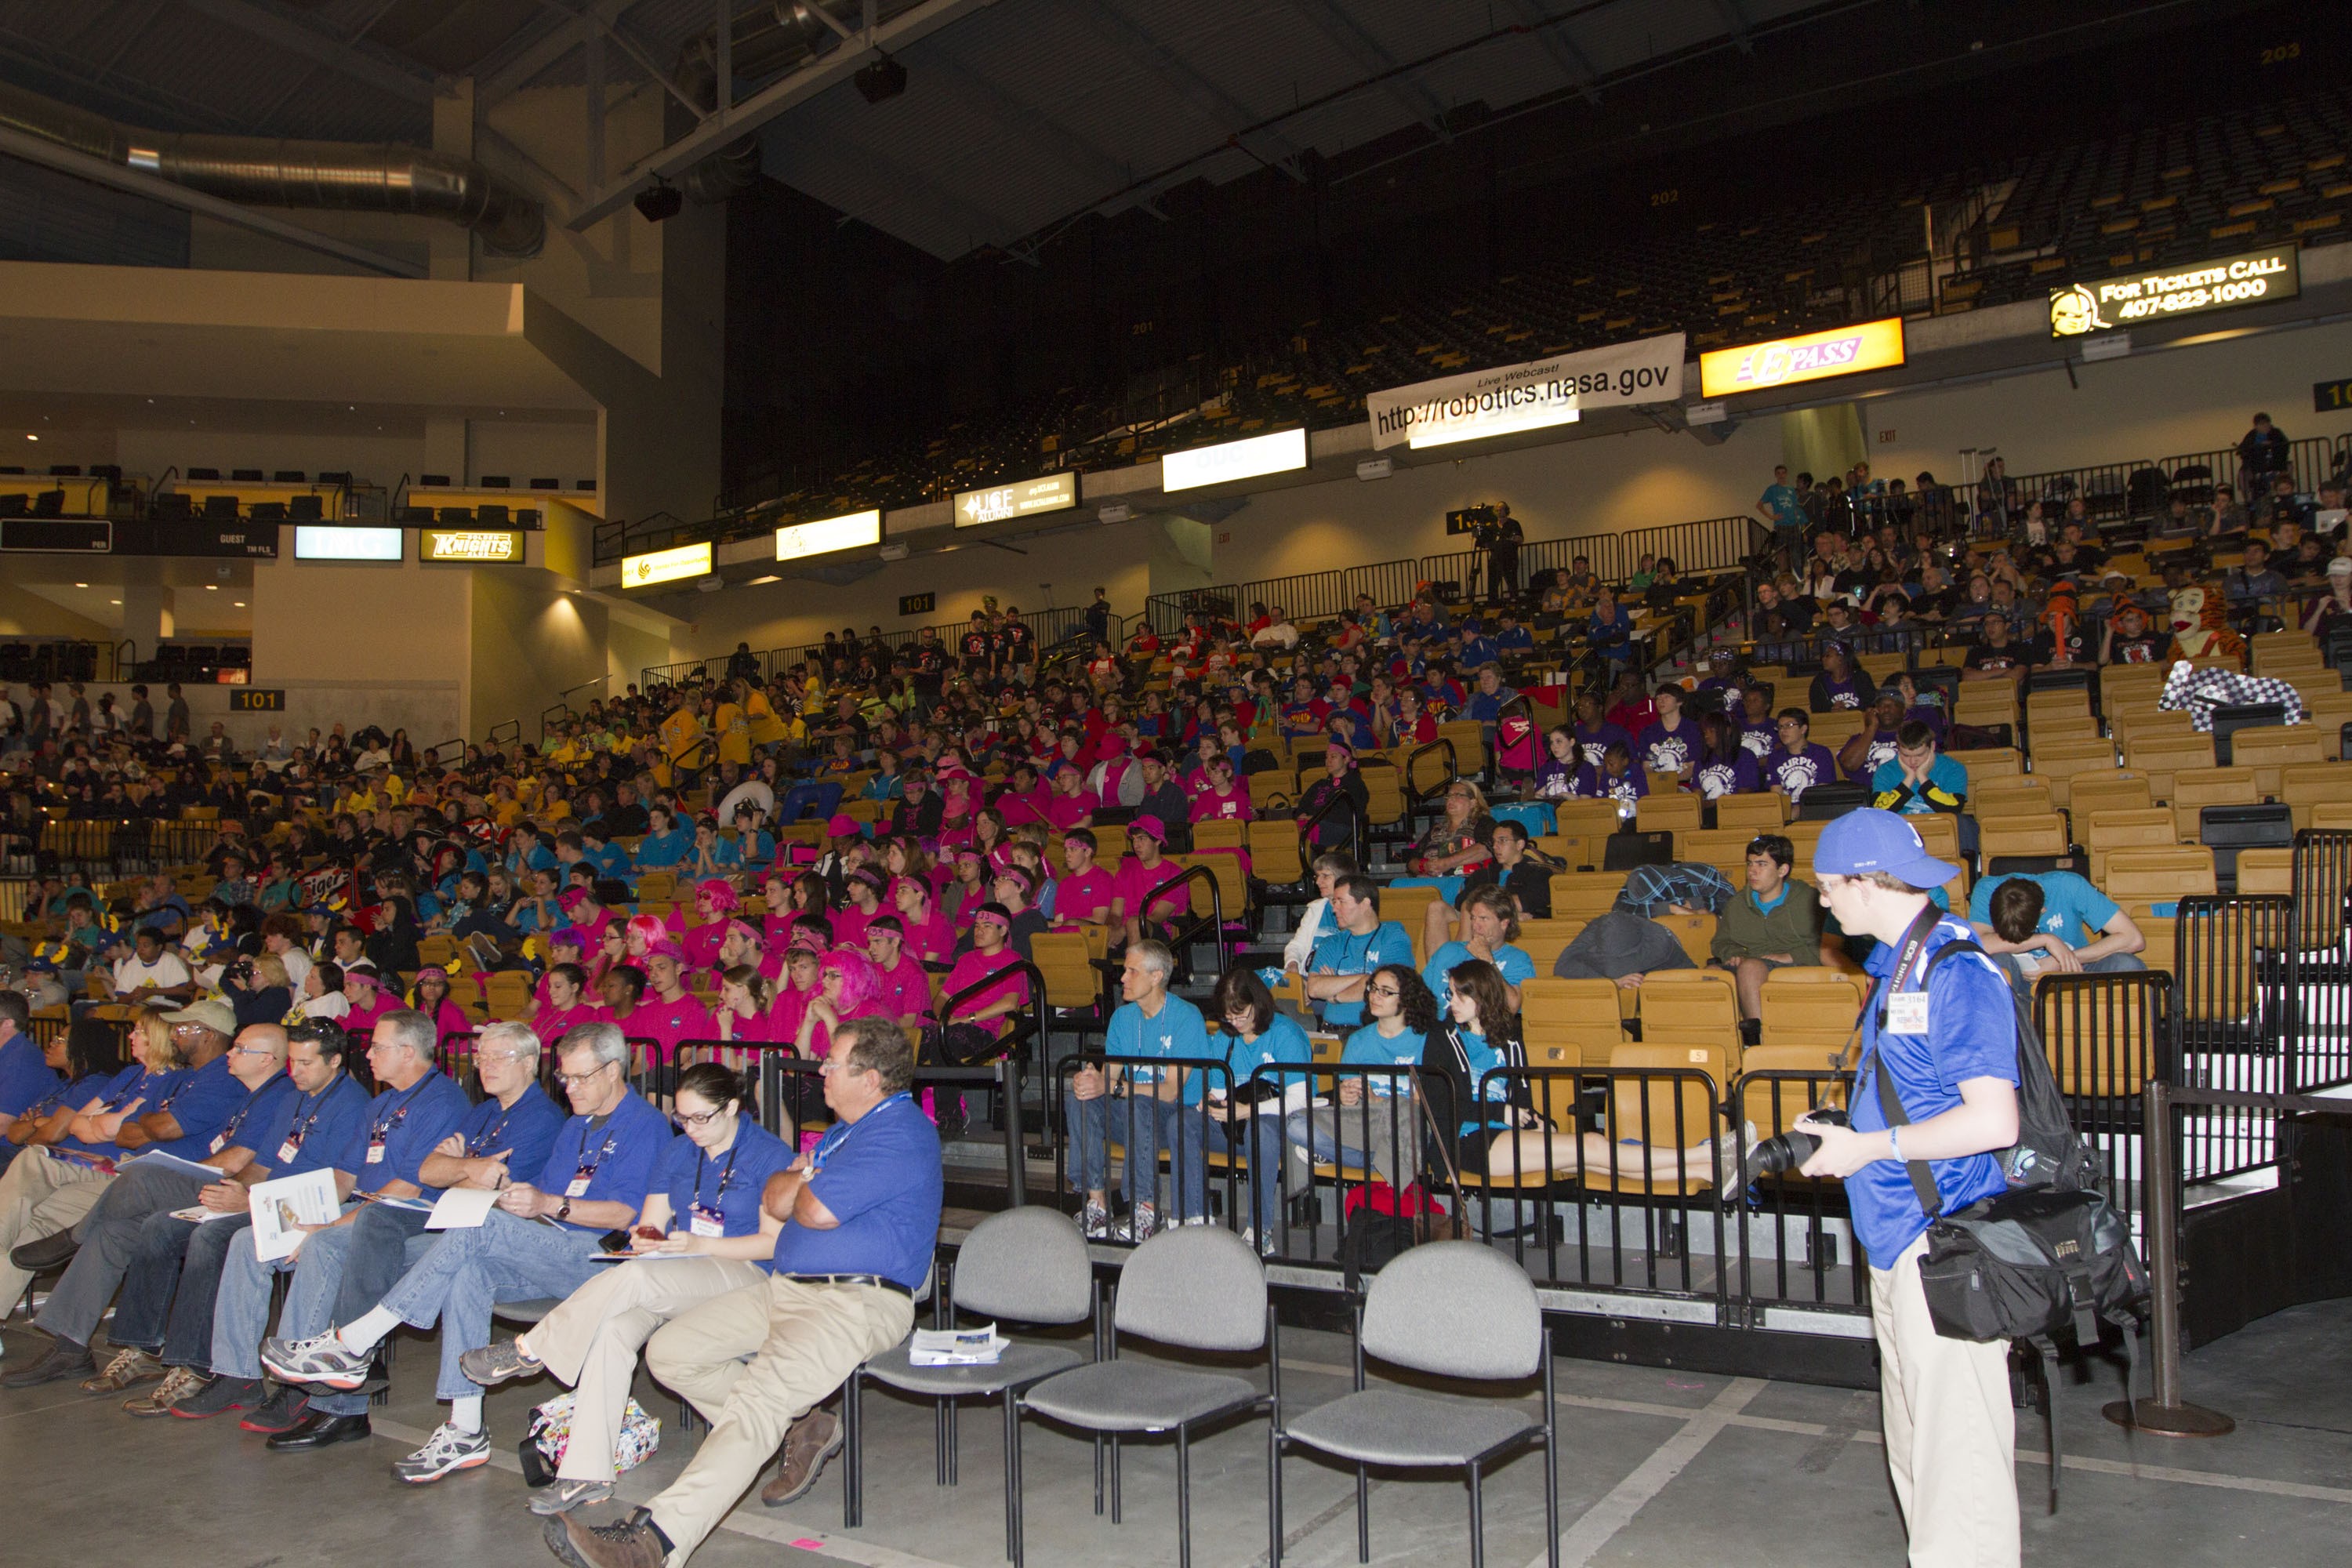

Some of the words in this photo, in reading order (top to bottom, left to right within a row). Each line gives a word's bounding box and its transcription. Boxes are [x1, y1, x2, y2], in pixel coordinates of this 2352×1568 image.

[2260, 42, 2301, 64] 203
[1650, 188, 1679, 207] 202
[2100, 282, 2142, 303] FOR
[2142, 267, 2227, 294] TICKETS
[2229, 257, 2287, 278] CALL
[2118, 278, 2267, 319] 407-823-1000
[1132, 319, 1154, 336] 201
[1477, 376, 1501, 388] Live
[1504, 364, 1560, 383] Webcast!
[1377, 365, 1670, 436] http://robotics.nasa.gov
[975, 488, 1014, 512] UCF
[977, 506, 1014, 523] ALUMNI
[92, 540, 107, 549] PER
[220, 533, 246, 544] GUEST
[437, 535, 510, 554] KNIGHTS
[246, 544, 257, 553] TM
[906, 596, 929, 612] 101
[240, 691, 275, 709] 101
[1777, 756, 1818, 775] PURPLE
[1903, 940, 1918, 962] EOS
[1907, 995, 1926, 1004] 3164
